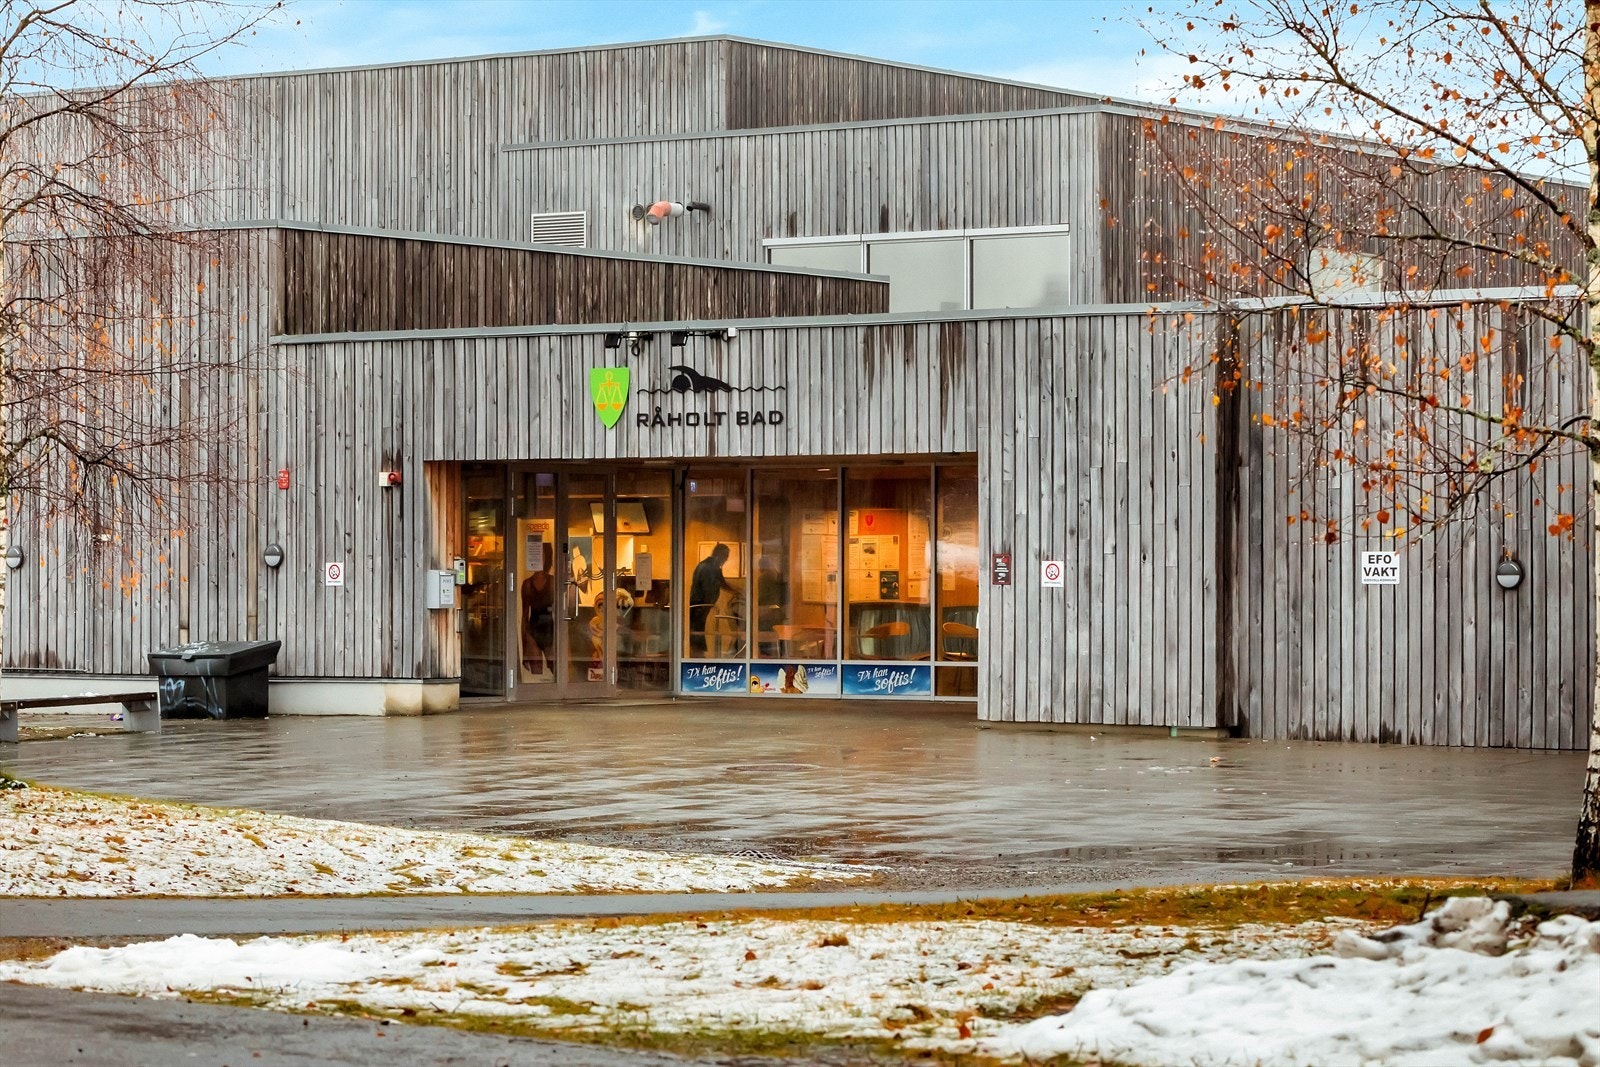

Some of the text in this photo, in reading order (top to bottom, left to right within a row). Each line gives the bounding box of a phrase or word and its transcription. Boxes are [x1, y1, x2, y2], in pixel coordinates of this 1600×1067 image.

[637, 406, 784, 427] RÅHOLT BAD
[1368, 554, 1392, 564] EFO
[1363, 567, 1397, 576] VAKT
[702, 665, 743, 690] softis!
[873, 668, 916, 693] softis!
